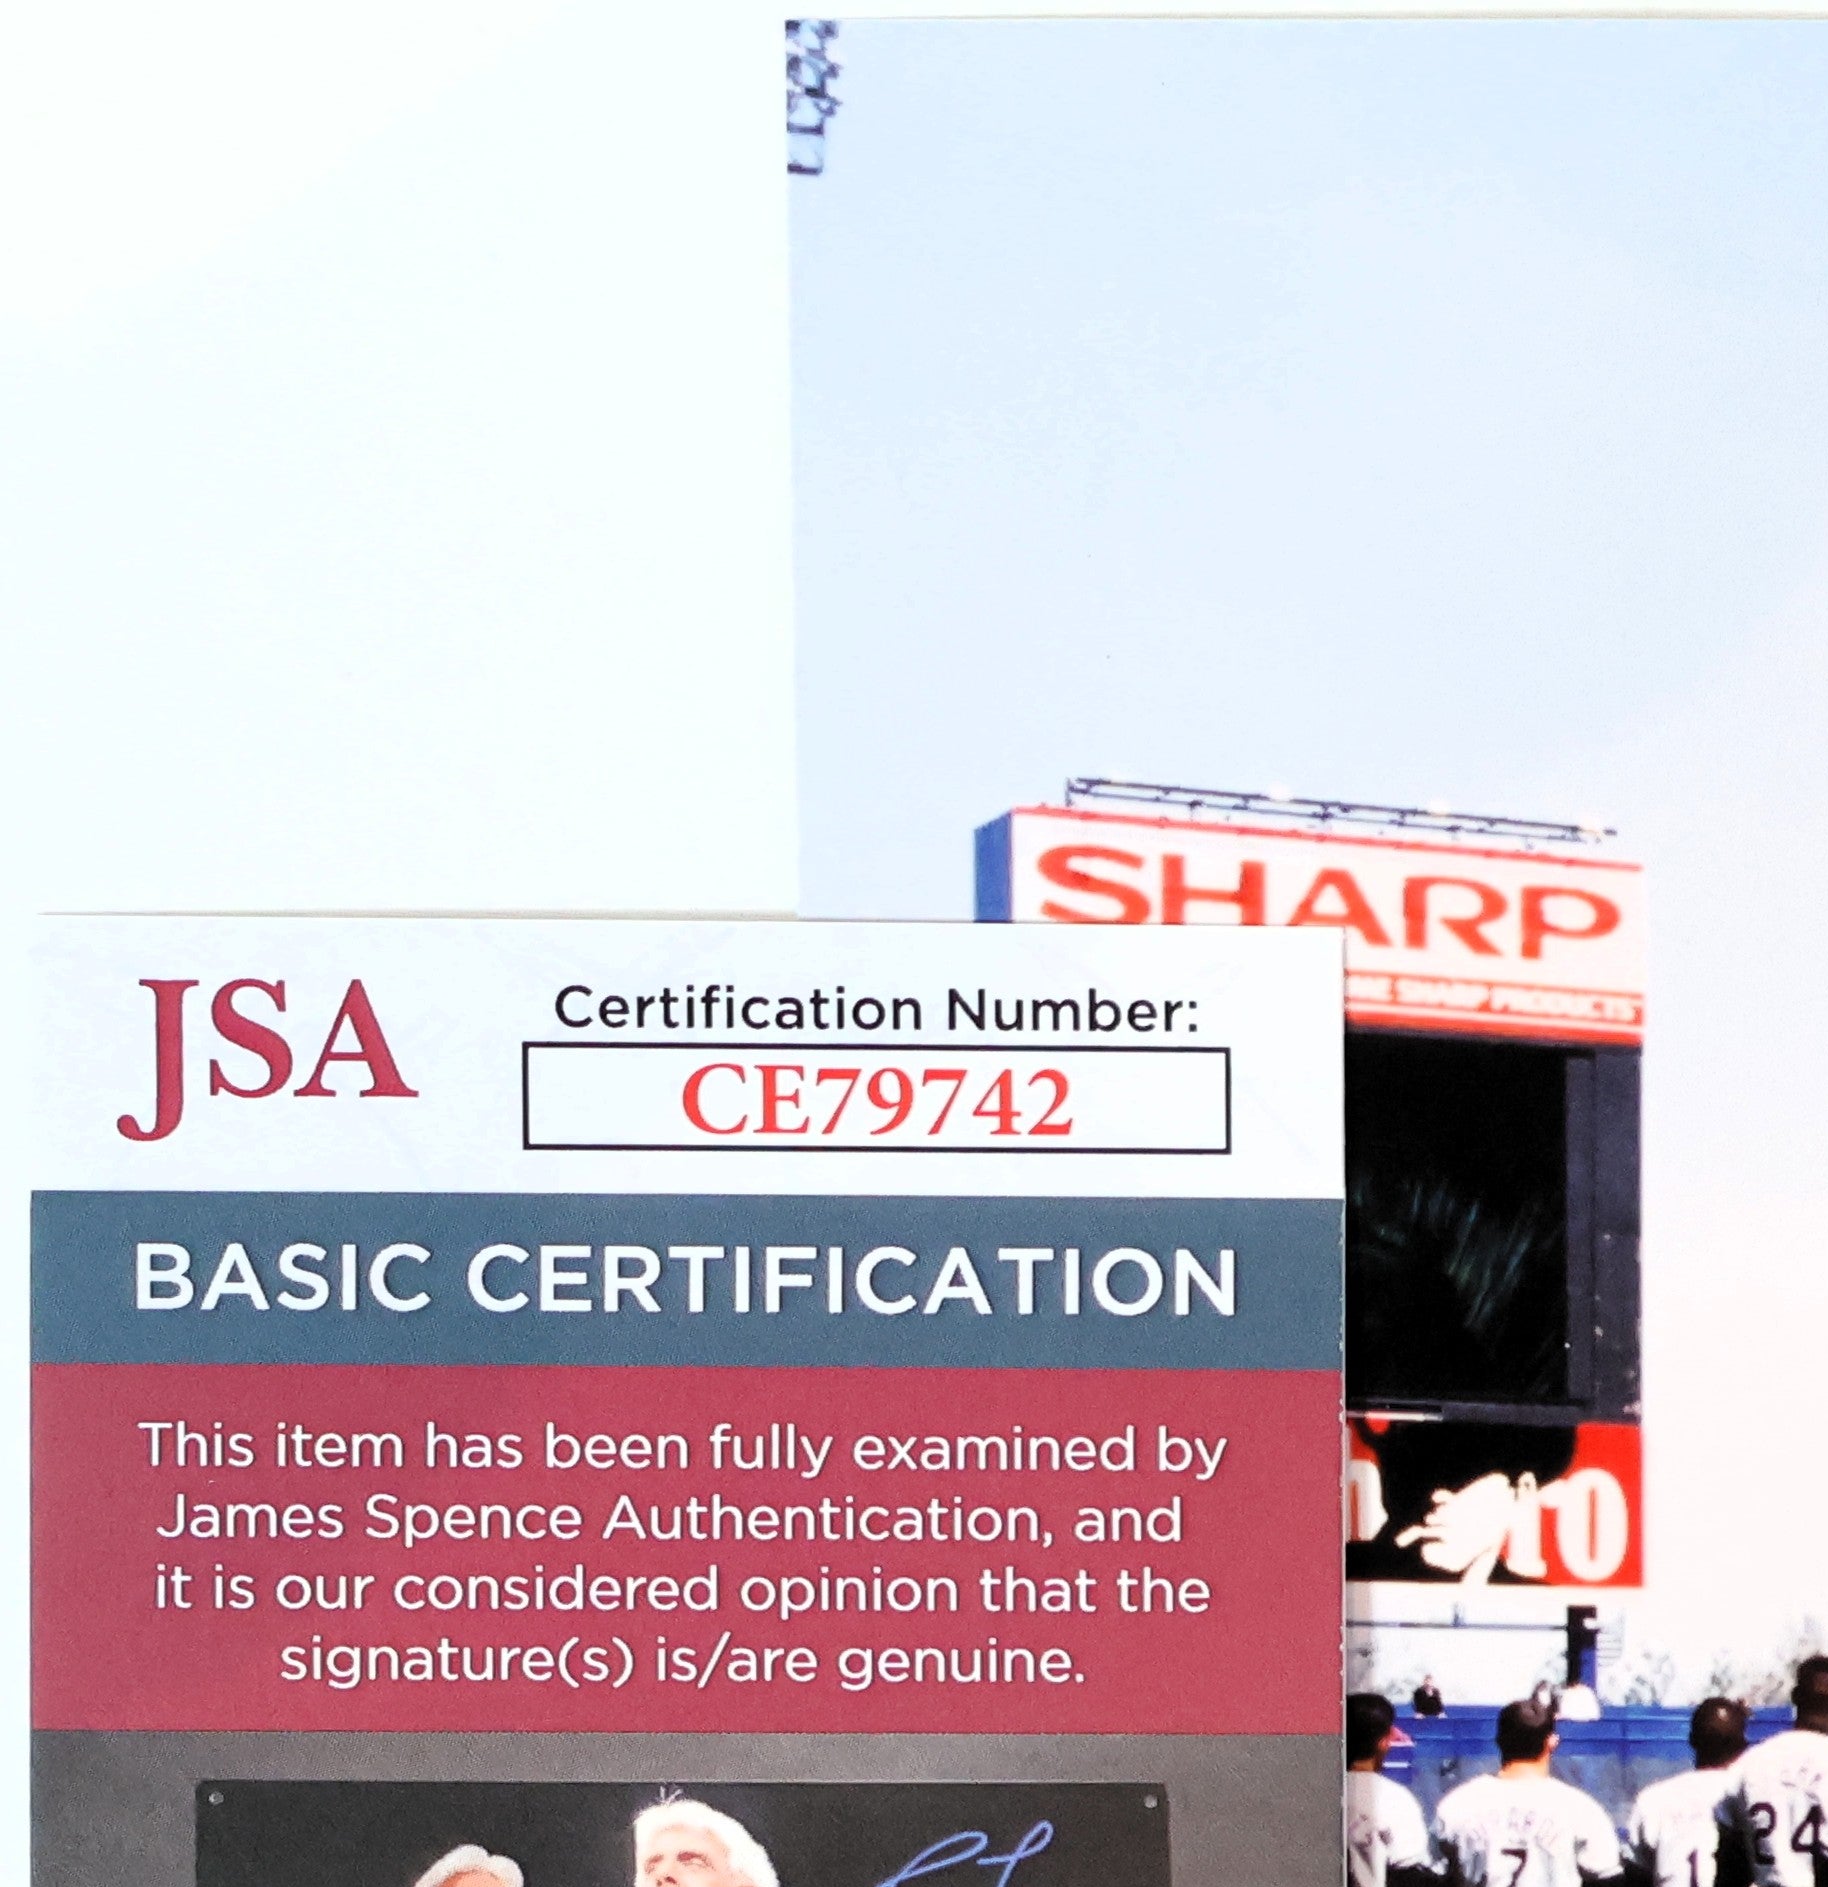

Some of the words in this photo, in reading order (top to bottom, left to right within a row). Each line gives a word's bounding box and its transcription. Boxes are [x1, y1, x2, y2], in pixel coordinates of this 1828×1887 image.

[1037, 844, 1621, 960] SHARP
[555, 985, 921, 1030] Certification
[949, 988, 1196, 1032] Number:
[115, 975, 420, 1145] JSA
[683, 1064, 1072, 1135] CE79742
[137, 1243, 430, 1311] BASIC
[468, 1244, 1234, 1316] CERTIFICATION
[138, 1421, 253, 1466] This
[278, 1422, 402, 1467] item
[428, 1422, 522, 1468] has
[547, 1422, 687, 1468] been
[710, 1423, 832, 1478] fully
[854, 1425, 1133, 1471] examined
[1159, 1426, 1226, 1480] by
[157, 1494, 343, 1538] James
[366, 1494, 581, 1548] Spence
[603, 1494, 1052, 1547] Authentication,
[1075, 1496, 1180, 1542] and
[158, 1564, 191, 1608] it
[216, 1564, 254, 1608] is
[277, 1575, 374, 1609] our
[395, 1564, 717, 1610] considered
[741, 1567, 956, 1620] opinion
[980, 1567, 1096, 1612] that
[1117, 1567, 1209, 1612] the
[281, 1635, 632, 1689] signature(s)
[658, 1632, 817, 1688] is/are
[839, 1638, 1083, 1690] genuine.
[1746, 1802, 1825, 1868] 24
